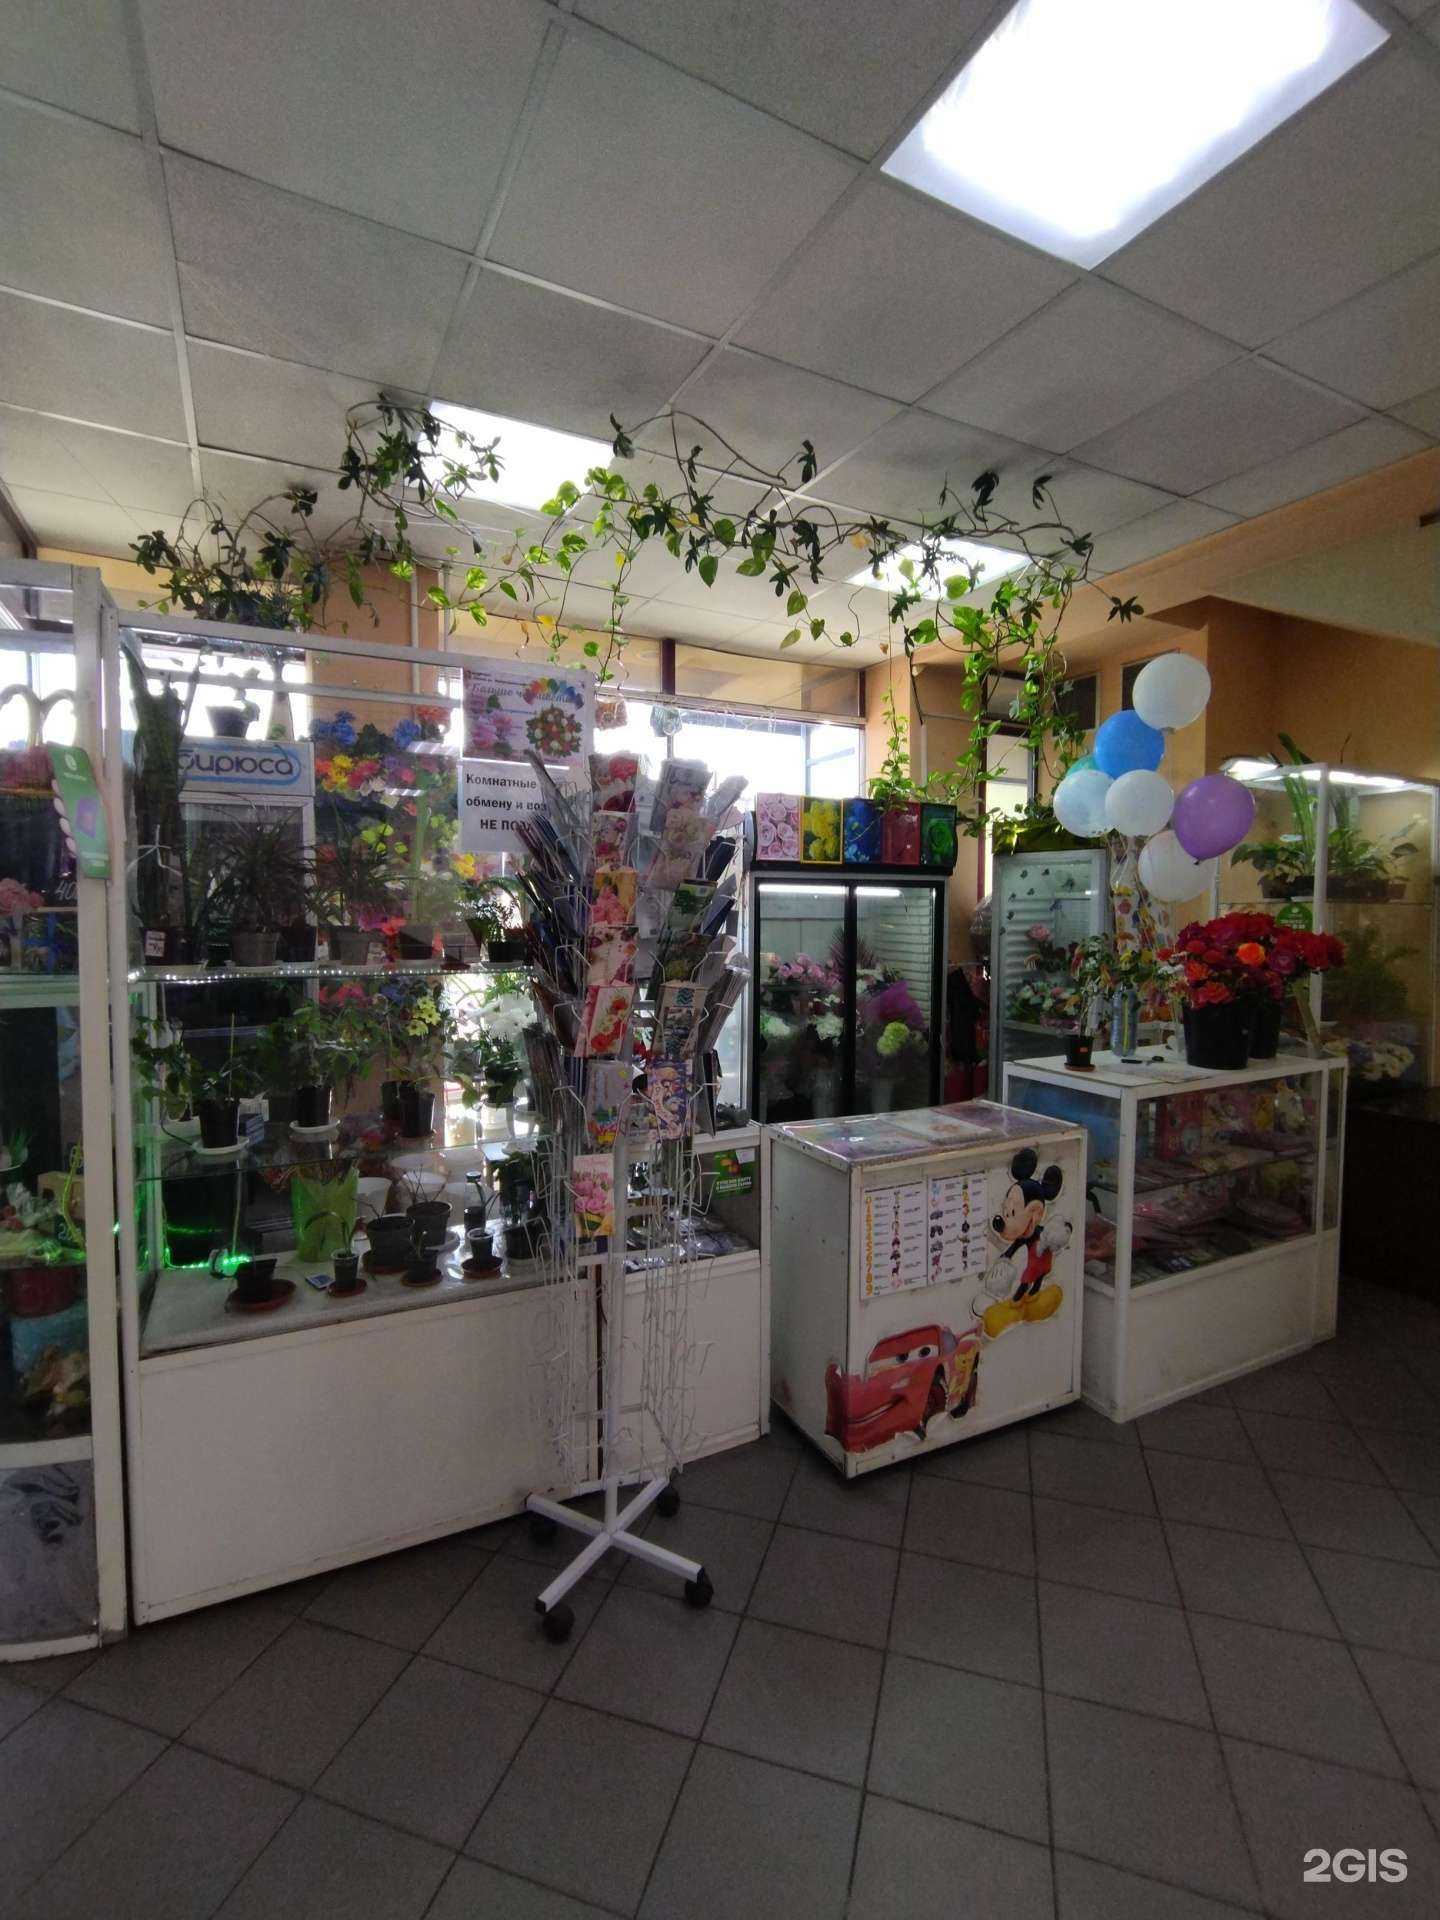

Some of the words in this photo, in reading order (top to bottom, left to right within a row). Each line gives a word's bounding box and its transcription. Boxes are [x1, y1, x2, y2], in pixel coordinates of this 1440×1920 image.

[466, 773, 537, 789] Комнатные
[466, 796, 512, 811] обмену
[526, 802, 547, 812] воз
[480, 818, 497, 831] НЕ
